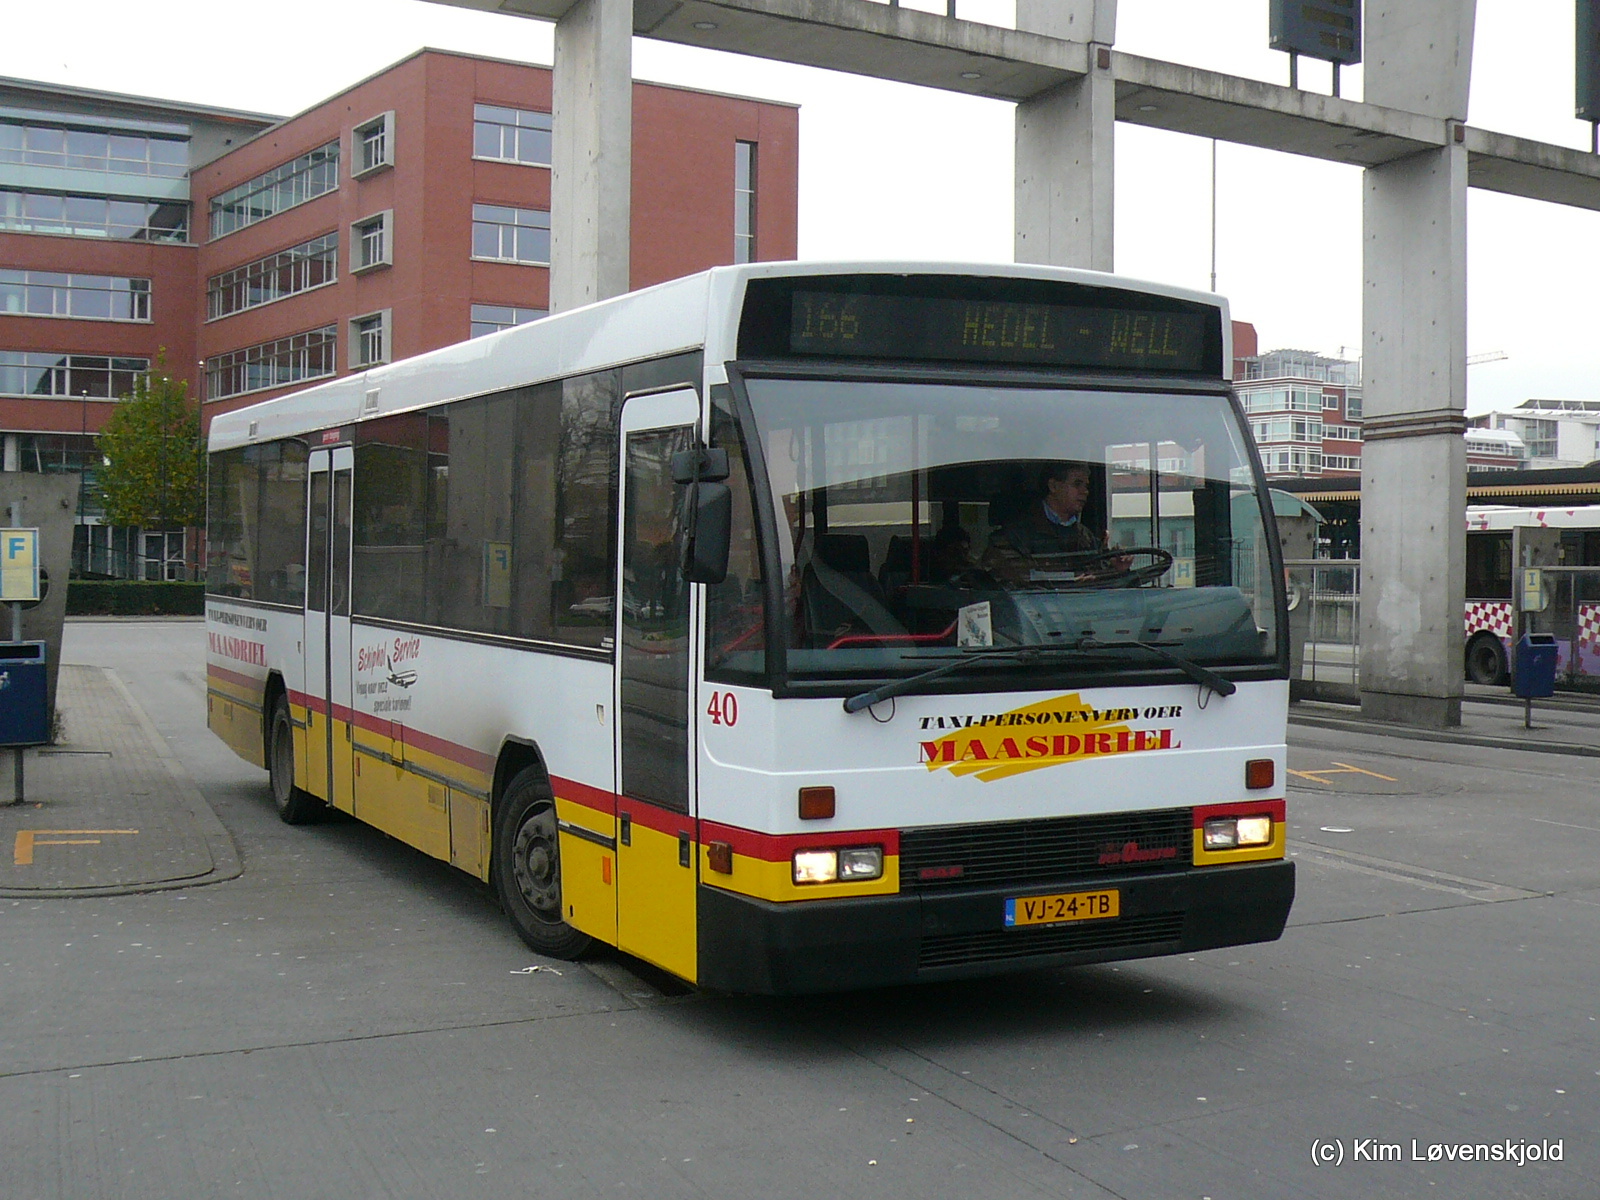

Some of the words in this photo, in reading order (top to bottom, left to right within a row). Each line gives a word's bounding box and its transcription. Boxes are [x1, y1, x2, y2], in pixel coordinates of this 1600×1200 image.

[1110, 313, 1178, 355] WELL
[9, 538, 25, 559] F
[1177, 563, 1190, 577] H
[208, 631, 268, 667] MAASDRIEL
[358, 641, 387, 675] Schiphol
[393, 635, 421, 663] Service
[706, 691, 738, 727] 40
[918, 705, 1182, 730] TAXI-PERSONENVERVOER
[917, 728, 1182, 764] MAASDRIEL
[1024, 894, 1110, 920] VJ-24-TB
